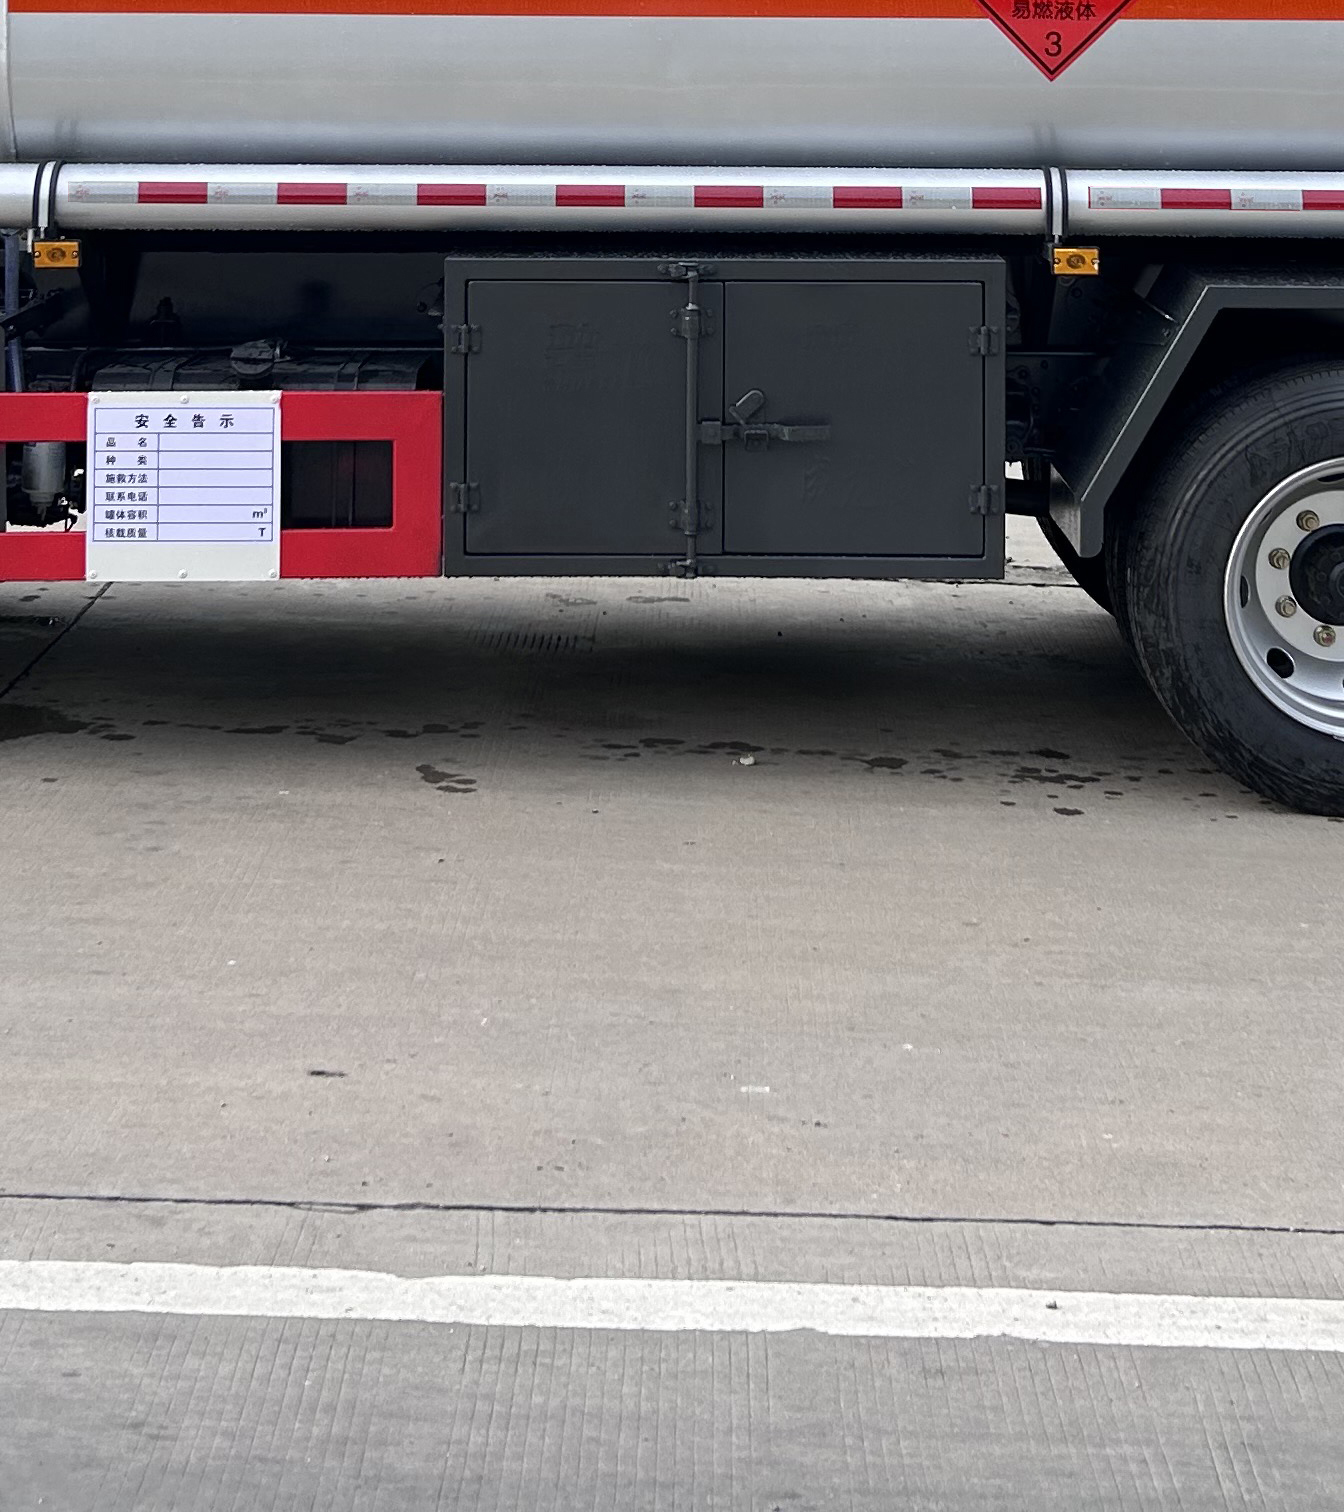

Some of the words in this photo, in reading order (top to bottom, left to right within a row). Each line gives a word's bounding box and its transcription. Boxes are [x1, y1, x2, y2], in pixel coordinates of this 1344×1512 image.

[1043, 30, 1063, 58] 3
[134, 413, 235, 429] 安全告示
[258, 527, 267, 538] T
